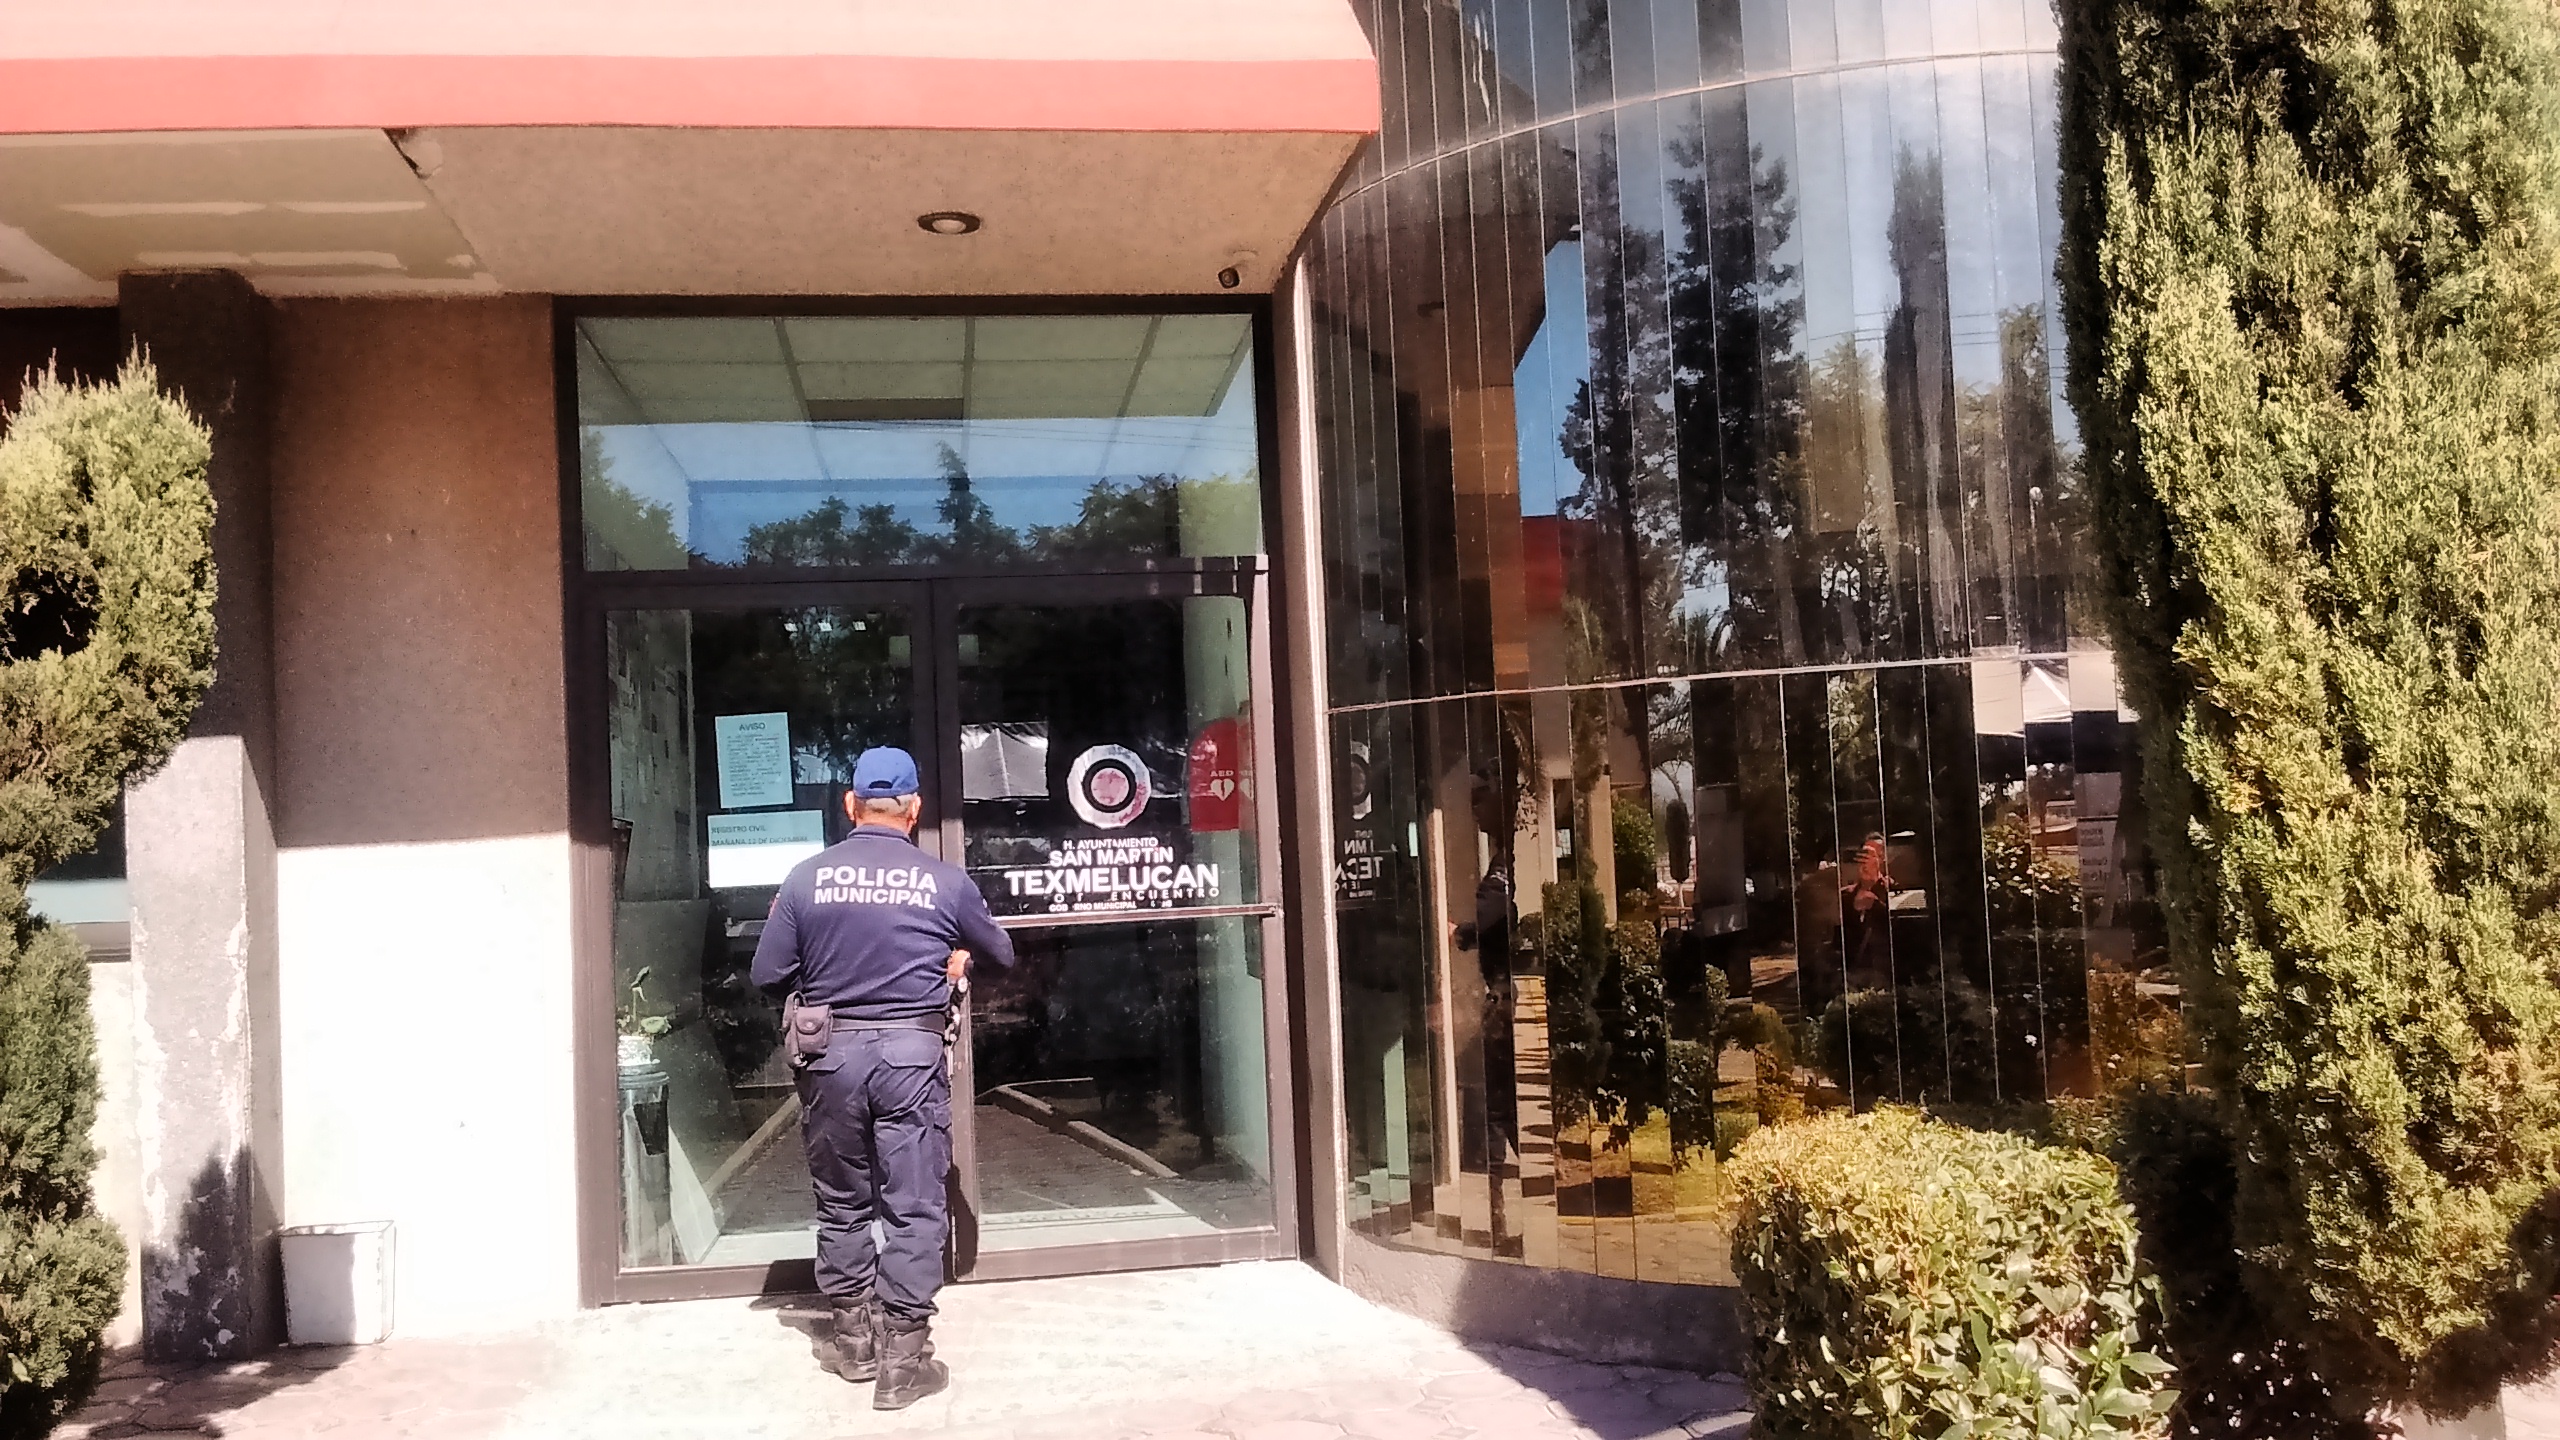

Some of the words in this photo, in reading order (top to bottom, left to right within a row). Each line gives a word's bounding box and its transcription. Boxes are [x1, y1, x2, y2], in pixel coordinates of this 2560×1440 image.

[739, 723, 766, 731] AVISO
[1063, 840, 1076, 850] H.
[1077, 837, 1159, 850] AYUNTAMIENTO
[1050, 850, 1092, 867] SAN
[815, 865, 938, 894] POLICÍA
[1004, 863, 1219, 896] TEXMELUCAN
[813, 887, 936, 911] MUNICIPAL
[1110, 887, 1220, 901] ENCUENTRO
